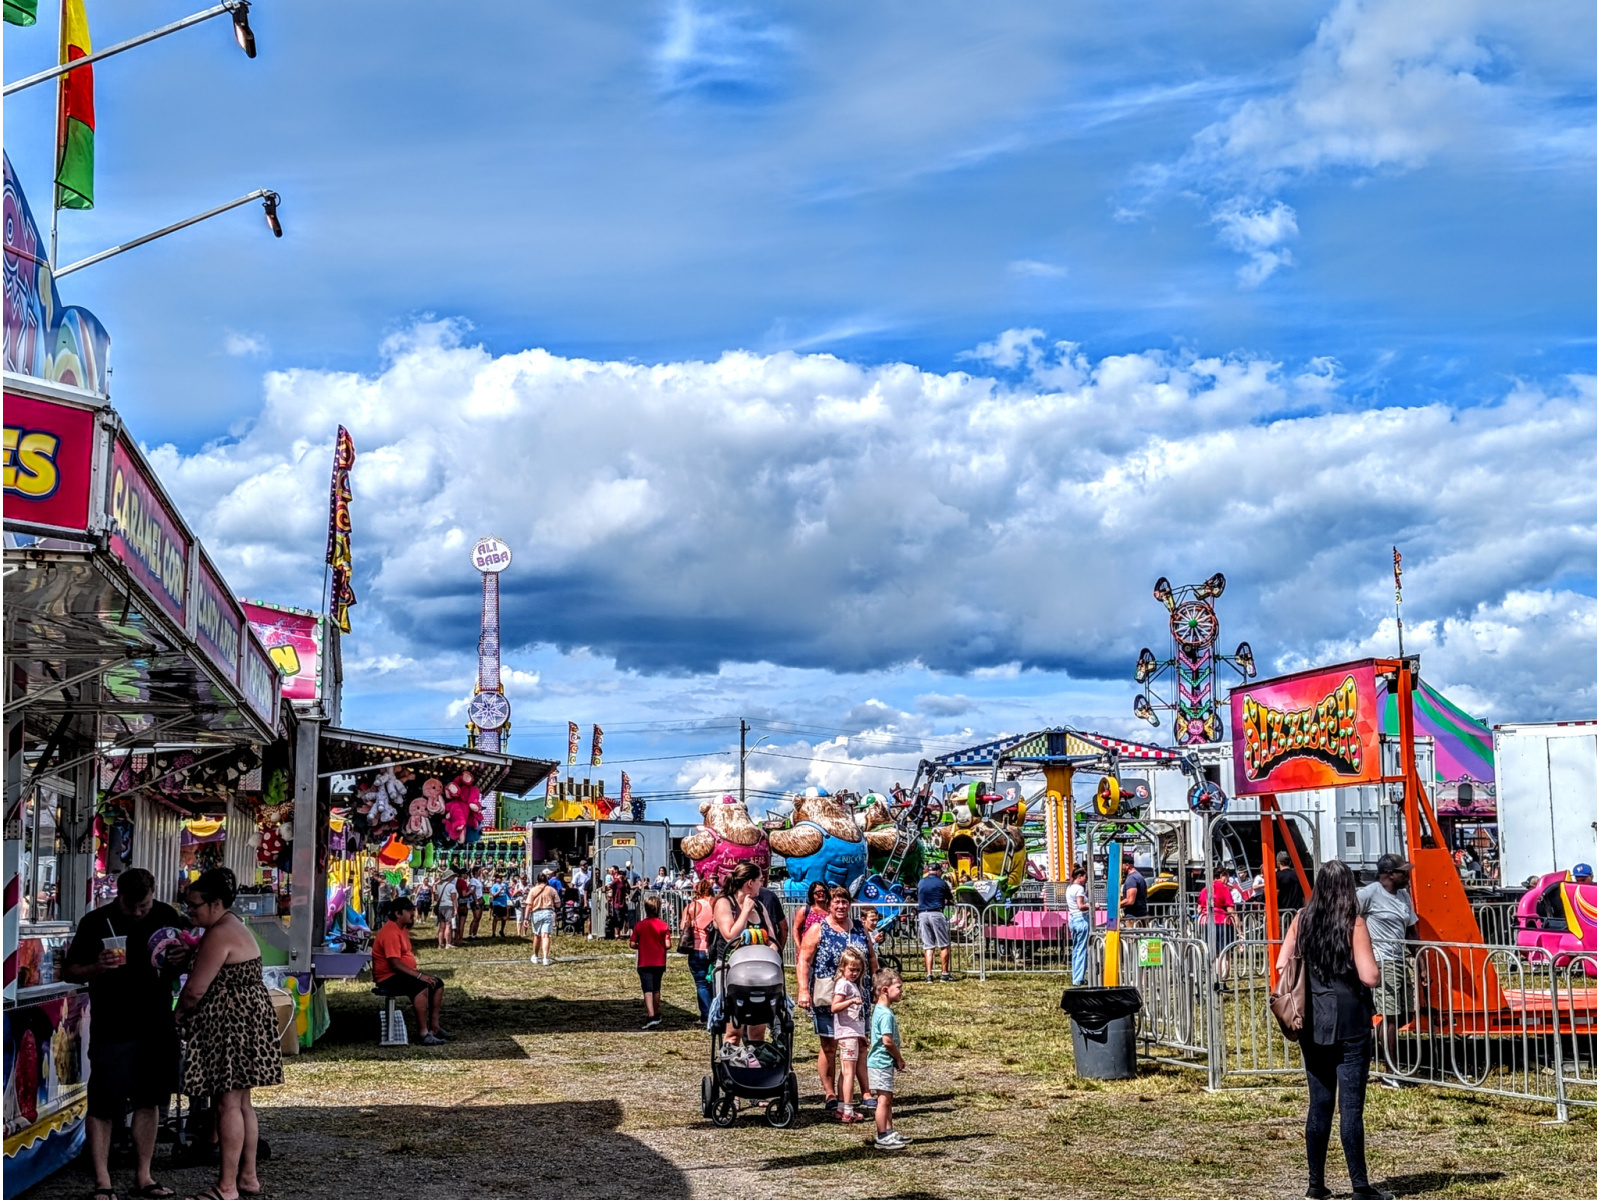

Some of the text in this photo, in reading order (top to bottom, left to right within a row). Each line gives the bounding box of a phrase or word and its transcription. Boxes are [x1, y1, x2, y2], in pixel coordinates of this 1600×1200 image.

[113, 468, 185, 606] CARAMEL CORN
[476, 551, 509, 567] BABA
[477, 541, 498, 555] ALI
[197, 582, 220, 644] CANDY
[1242, 675, 1362, 780] SIZZLER
